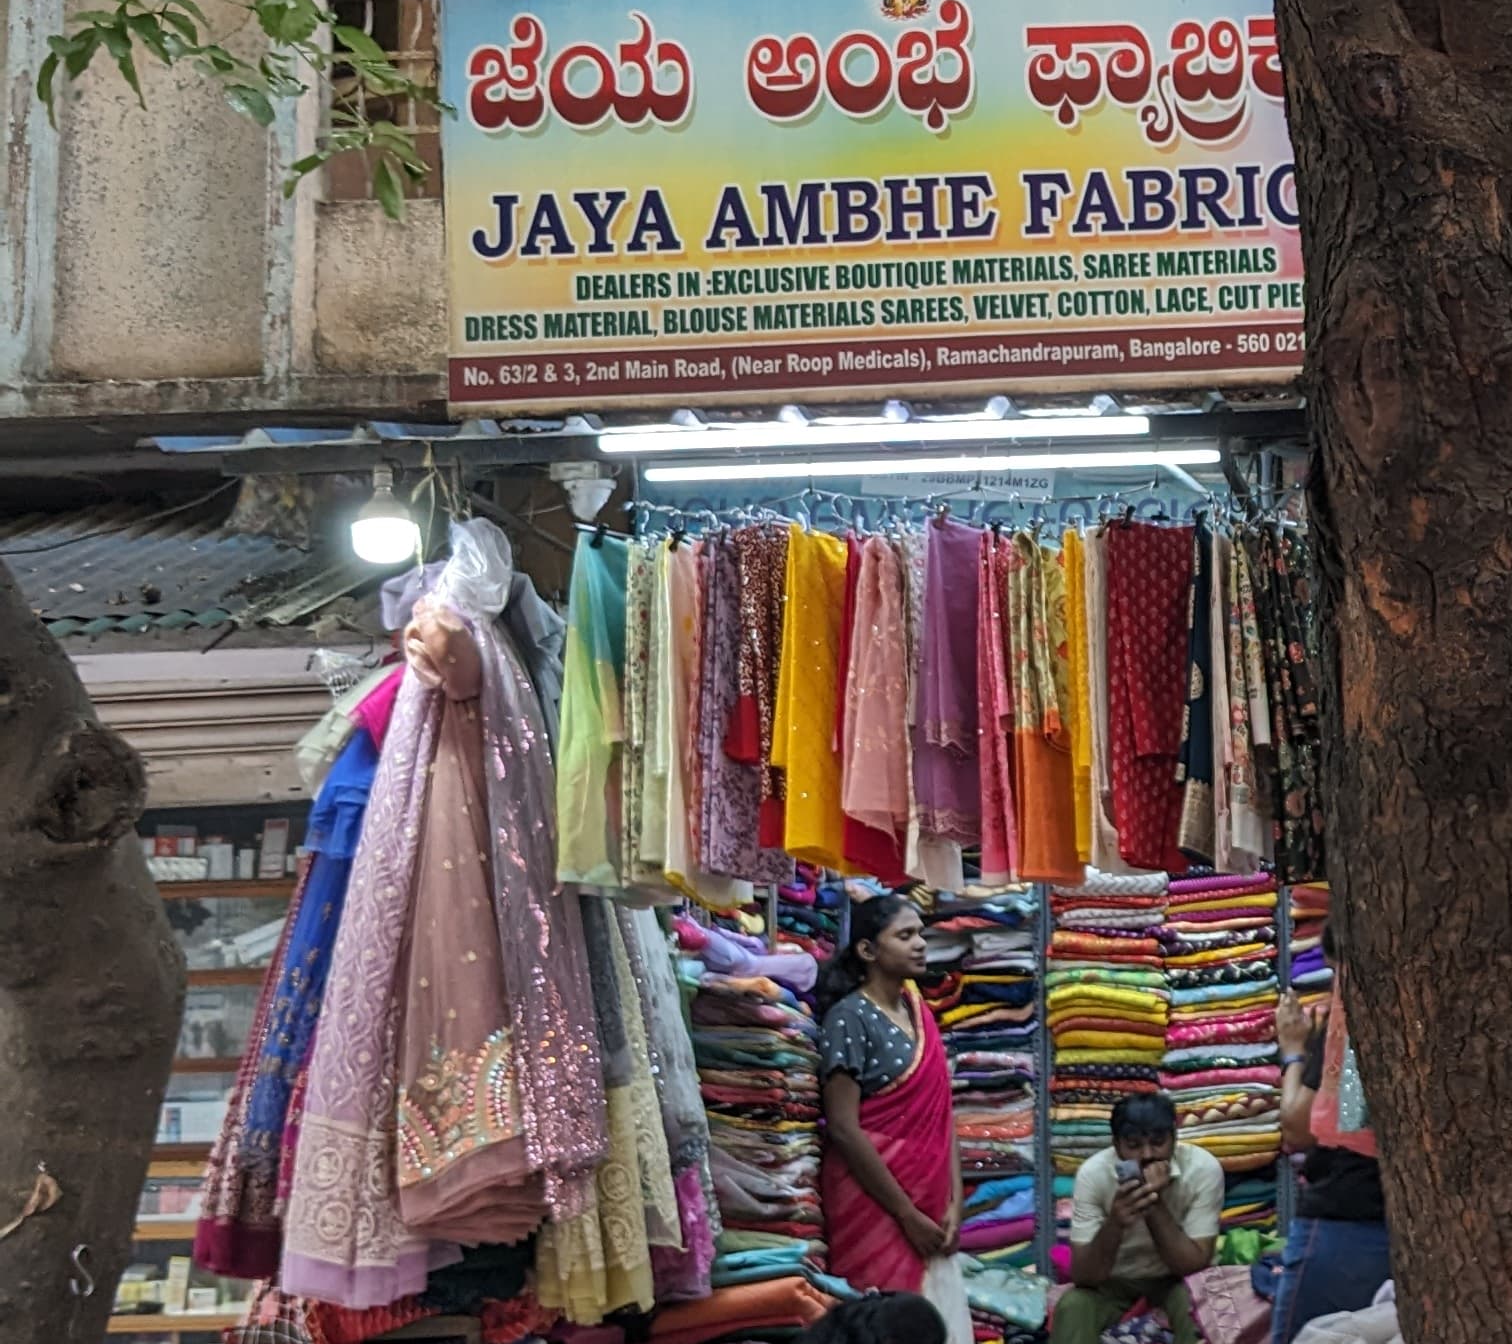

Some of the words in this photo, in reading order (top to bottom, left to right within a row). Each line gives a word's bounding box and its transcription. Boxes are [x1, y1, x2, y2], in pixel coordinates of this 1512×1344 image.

[473, 189, 681, 257] JAYA
[705, 174, 997, 249] AMBHE
[1022, 164, 1301, 236] FABRIC
[577, 270, 673, 301] DEALERS
[678, 270, 701, 297] IN
[836, 259, 947, 290] BOUTIQUE
[953, 254, 1079, 285] MATERIALS,
[1084, 252, 1151, 280] SAREE
[1157, 247, 1277, 277] MATERIALS
[465, 313, 538, 342] DRESS
[544, 309, 658, 339] MATERIAL,
[664, 306, 748, 334] BLOUSE
[754, 301, 875, 331] MATERIALS
[881, 296, 969, 327] SAREES,
[974, 293, 1052, 320] VELVET,
[1058, 289, 1151, 317] COTTON,
[1156, 286, 1213, 313] LACE,
[1219, 284, 1262, 311] CUT
[1268, 283, 1305, 309] PIE
[464, 366, 494, 386] No.
[500, 363, 538, 385] 63/2
[544, 364, 557, 382] &
[564, 364, 580, 385] 3,
[586, 361, 620, 381] 2nd
[625, 359, 669, 380] Main
[675, 359, 726, 381] Road,
[732, 354, 782, 380] (Near
[787, 353, 832, 376] Roop
[839, 347, 932, 373] Medicals),
[937, 340, 1124, 367] Ramachandrapuram,
[1130, 337, 1221, 362] Bangalore
[1238, 333, 1270, 354] 560
